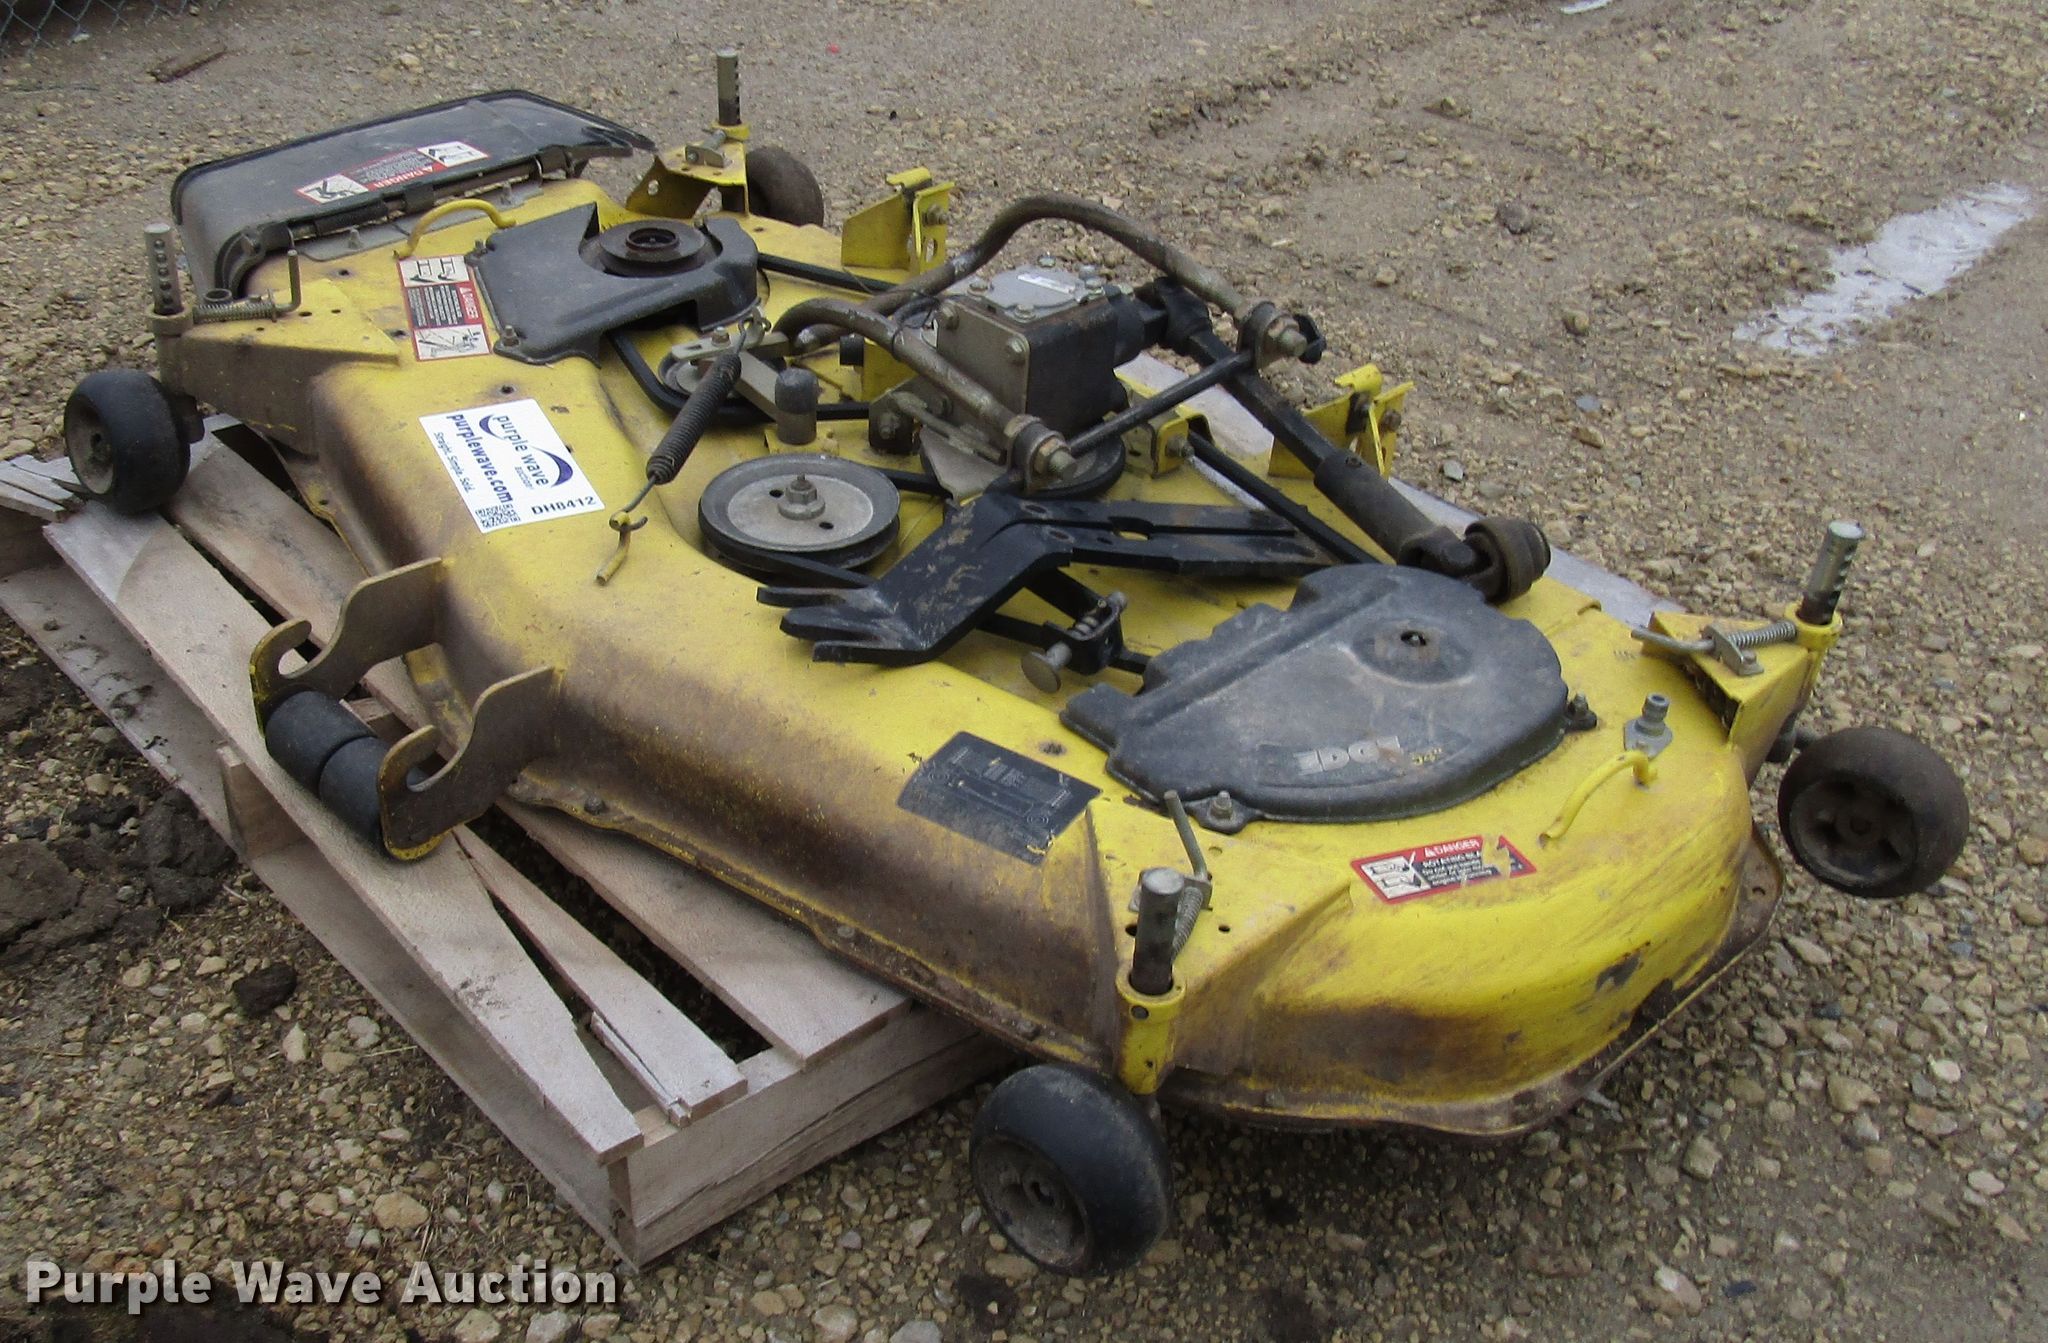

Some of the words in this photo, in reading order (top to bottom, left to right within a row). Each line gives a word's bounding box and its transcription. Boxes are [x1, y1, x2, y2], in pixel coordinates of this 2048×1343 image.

[446, 414, 514, 504] purplewave.com
[492, 415, 529, 453] purple
[520, 452, 550, 487] wave
[531, 496, 597, 515] DH8412
[1433, 839, 1481, 855] DANGER
